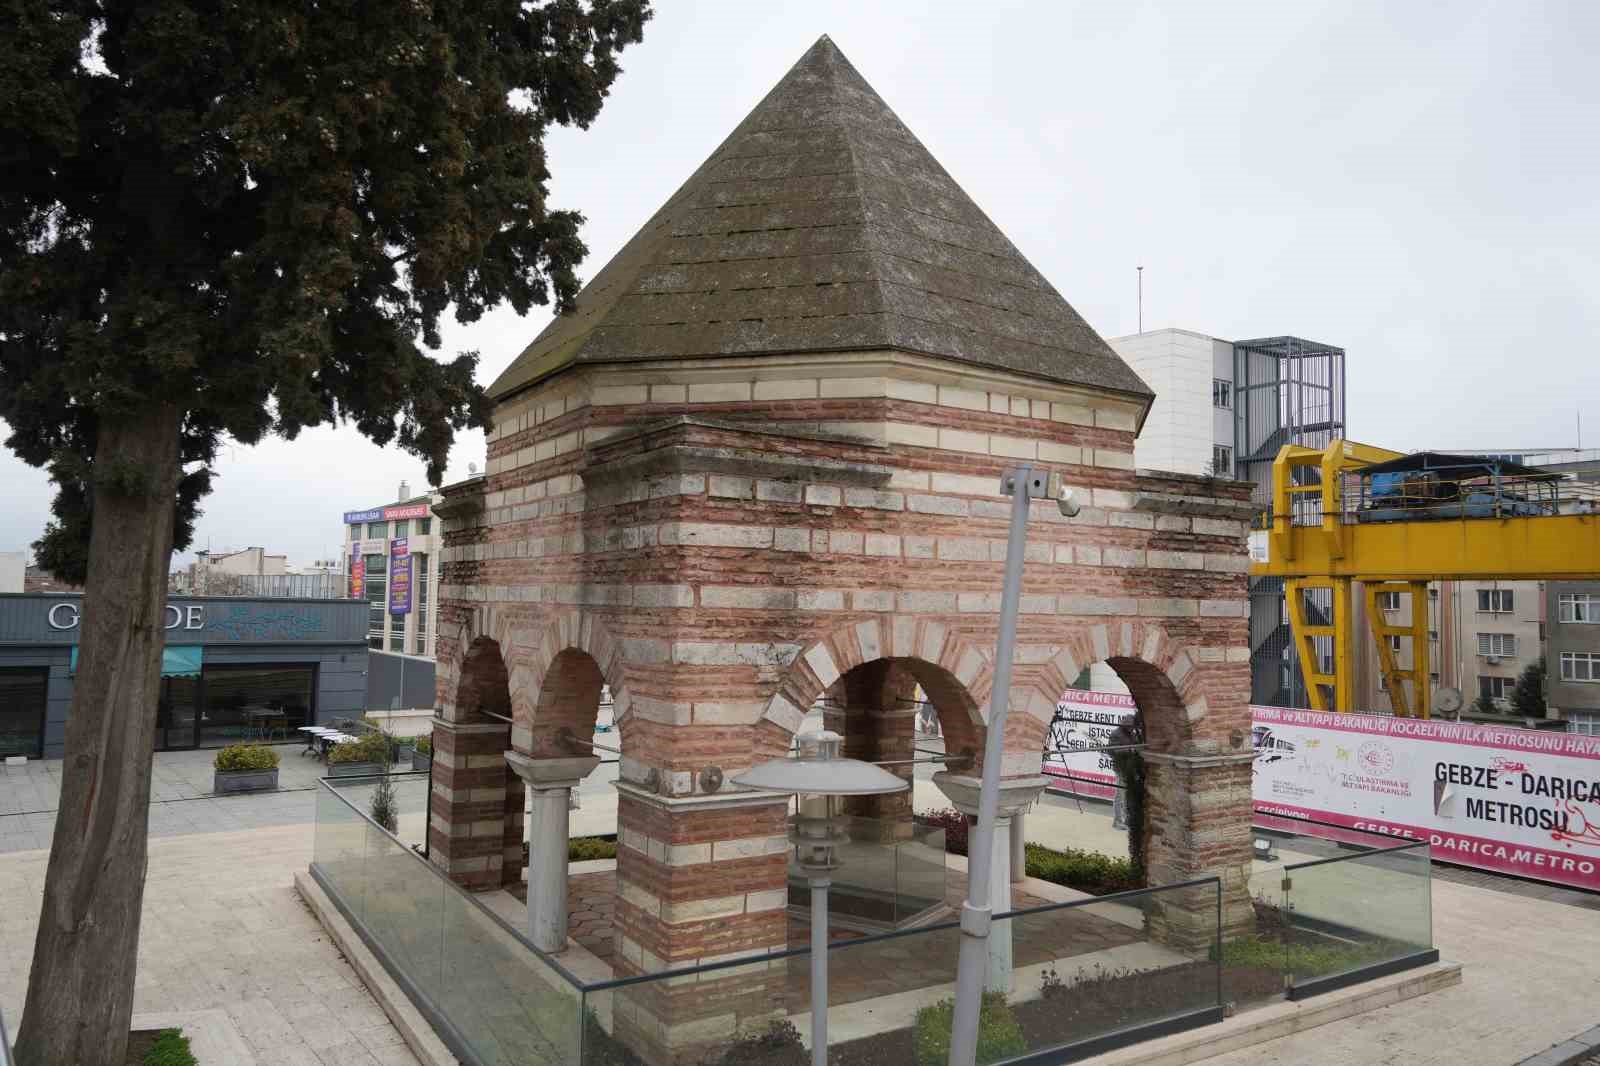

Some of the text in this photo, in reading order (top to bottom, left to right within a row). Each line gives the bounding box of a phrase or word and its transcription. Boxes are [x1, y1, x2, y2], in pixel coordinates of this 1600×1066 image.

[1482, 731, 1563, 750] METROSUNU
[1435, 761, 1498, 790] GEBZE
[1466, 798, 1568, 832] METROSU
[1430, 834, 1508, 859] DARICA
